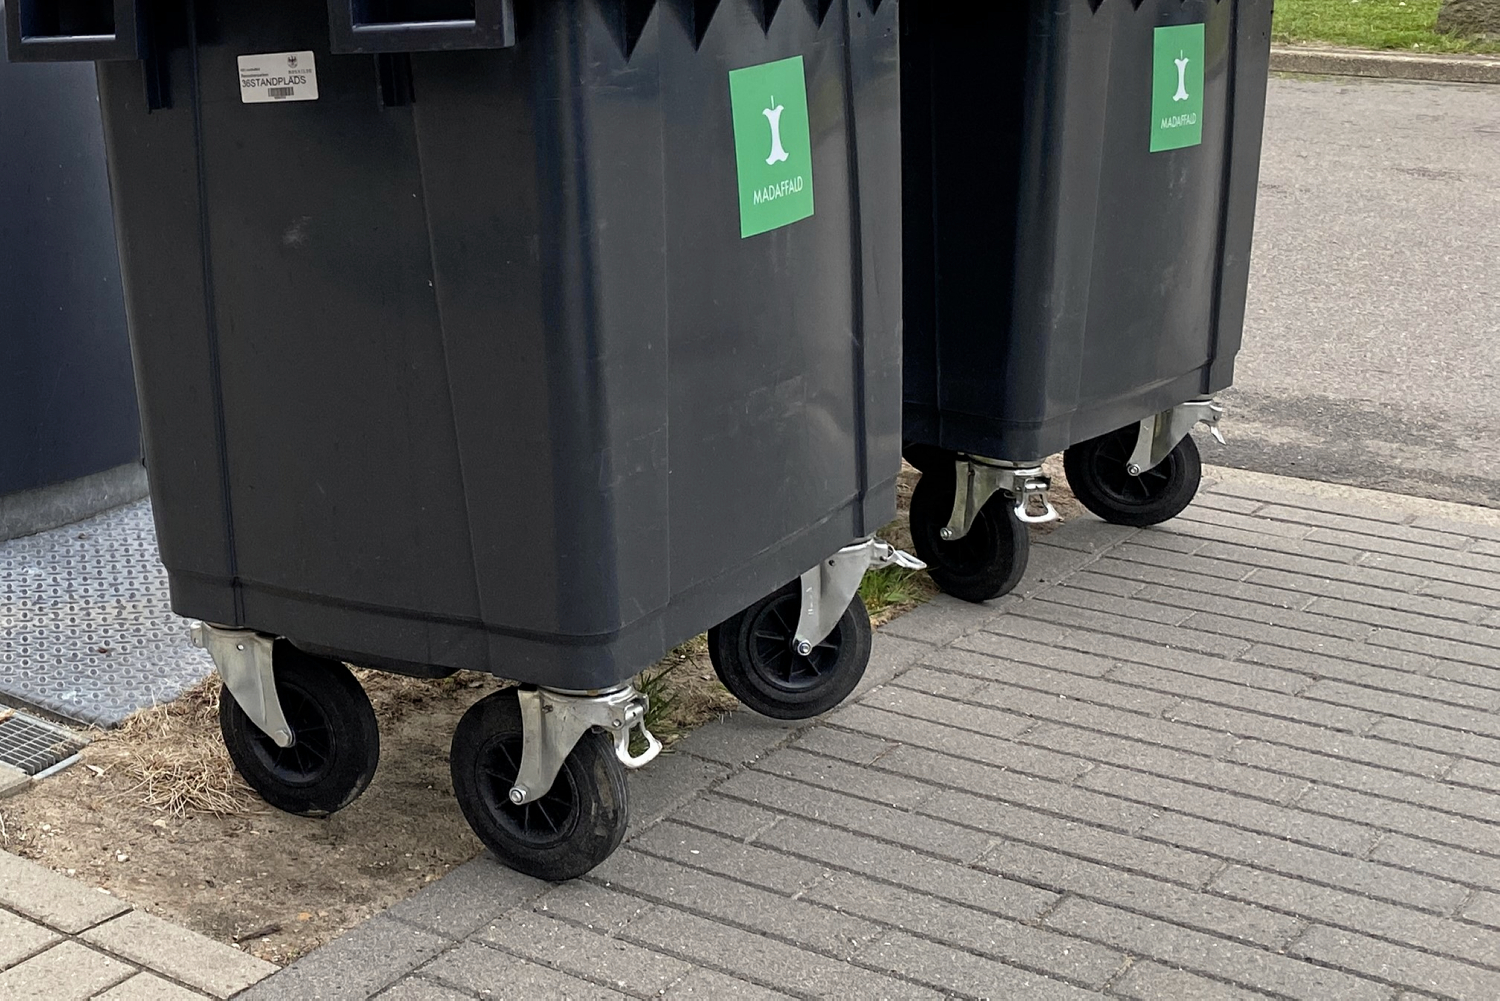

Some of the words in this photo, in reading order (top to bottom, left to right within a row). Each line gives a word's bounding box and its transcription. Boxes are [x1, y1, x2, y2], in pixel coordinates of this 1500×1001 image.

[241, 75, 307, 88] 36STANDPLADS
[1161, 112, 1197, 129] MADAFFALD
[753, 175, 804, 206] MADAFFALD
